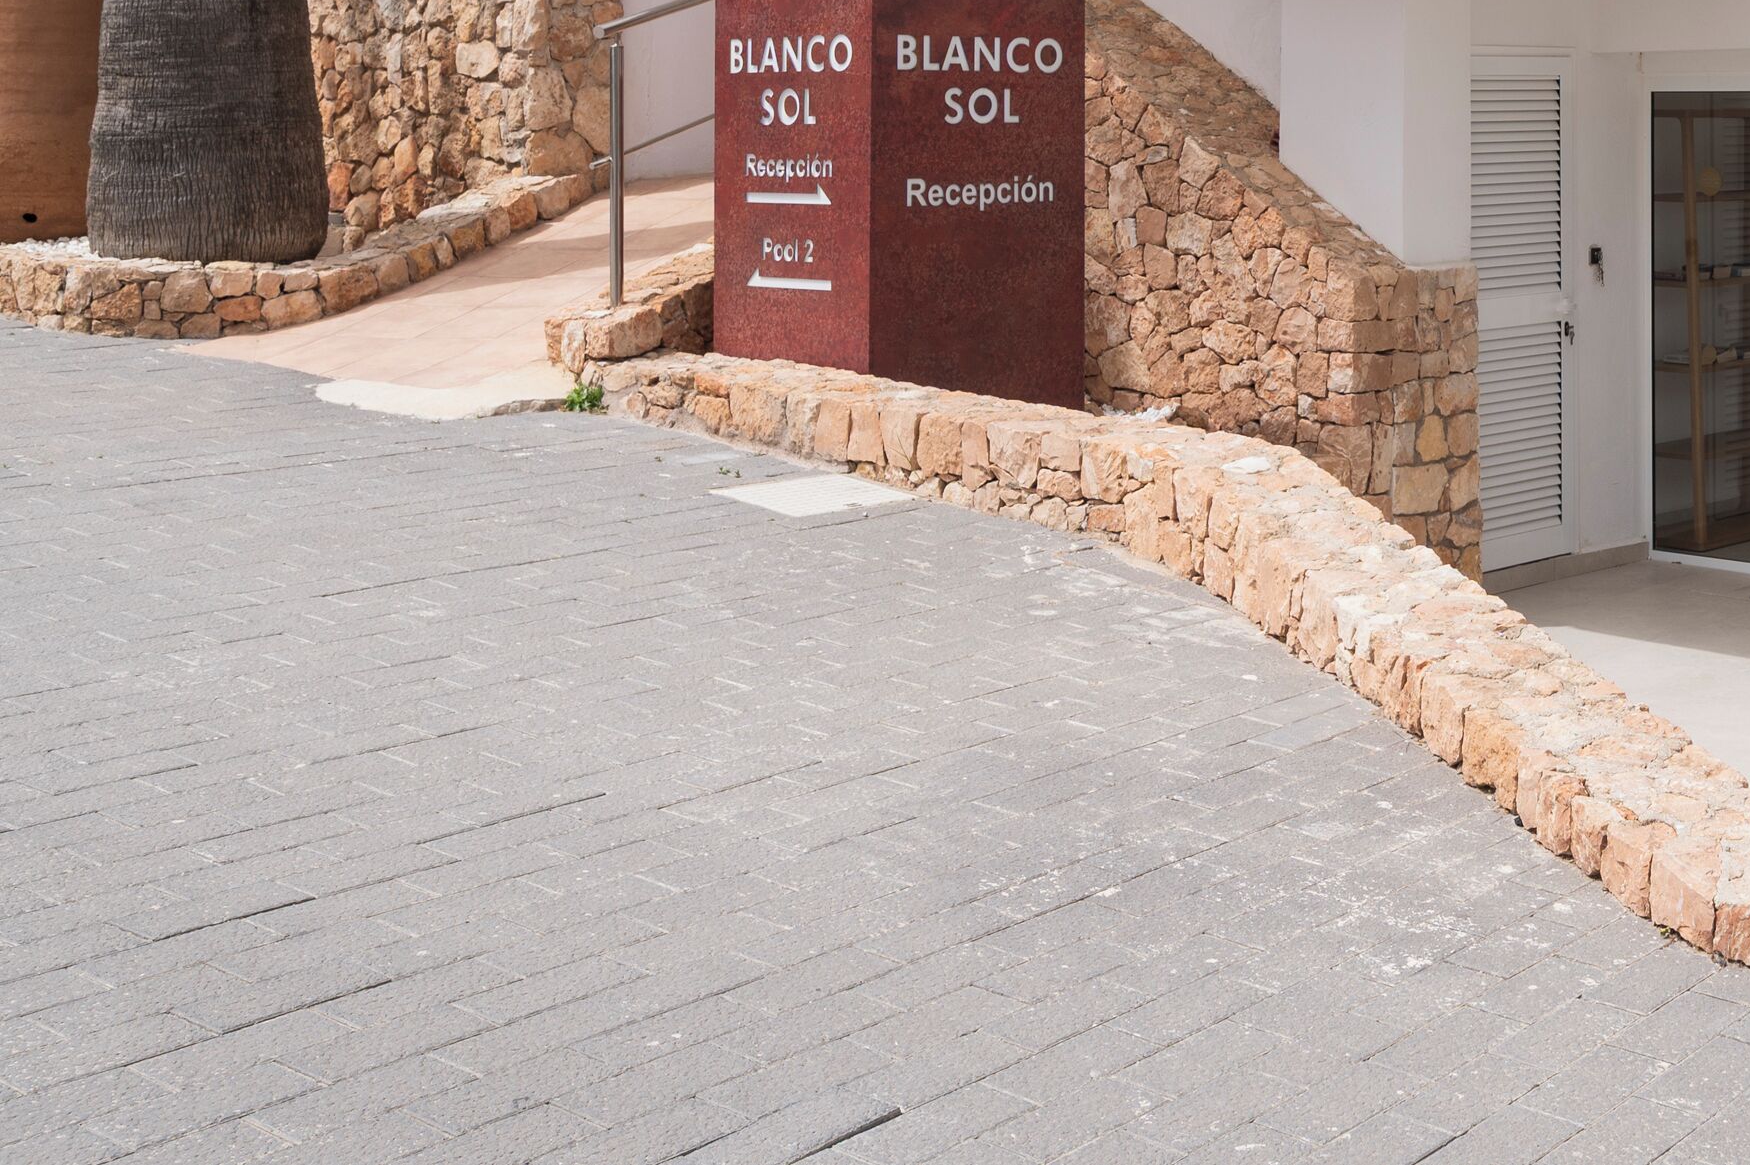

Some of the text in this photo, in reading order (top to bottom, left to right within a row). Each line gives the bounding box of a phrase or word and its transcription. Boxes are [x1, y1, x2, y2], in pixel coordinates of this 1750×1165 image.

[729, 32, 853, 75] BLANCO
[896, 34, 1063, 74] BLANCO
[759, 87, 817, 127] SOL
[944, 87, 1020, 125] SOL
[745, 151, 833, 182] Recepción
[906, 175, 1054, 212] Recepción
[762, 236, 815, 264] Pool 2
